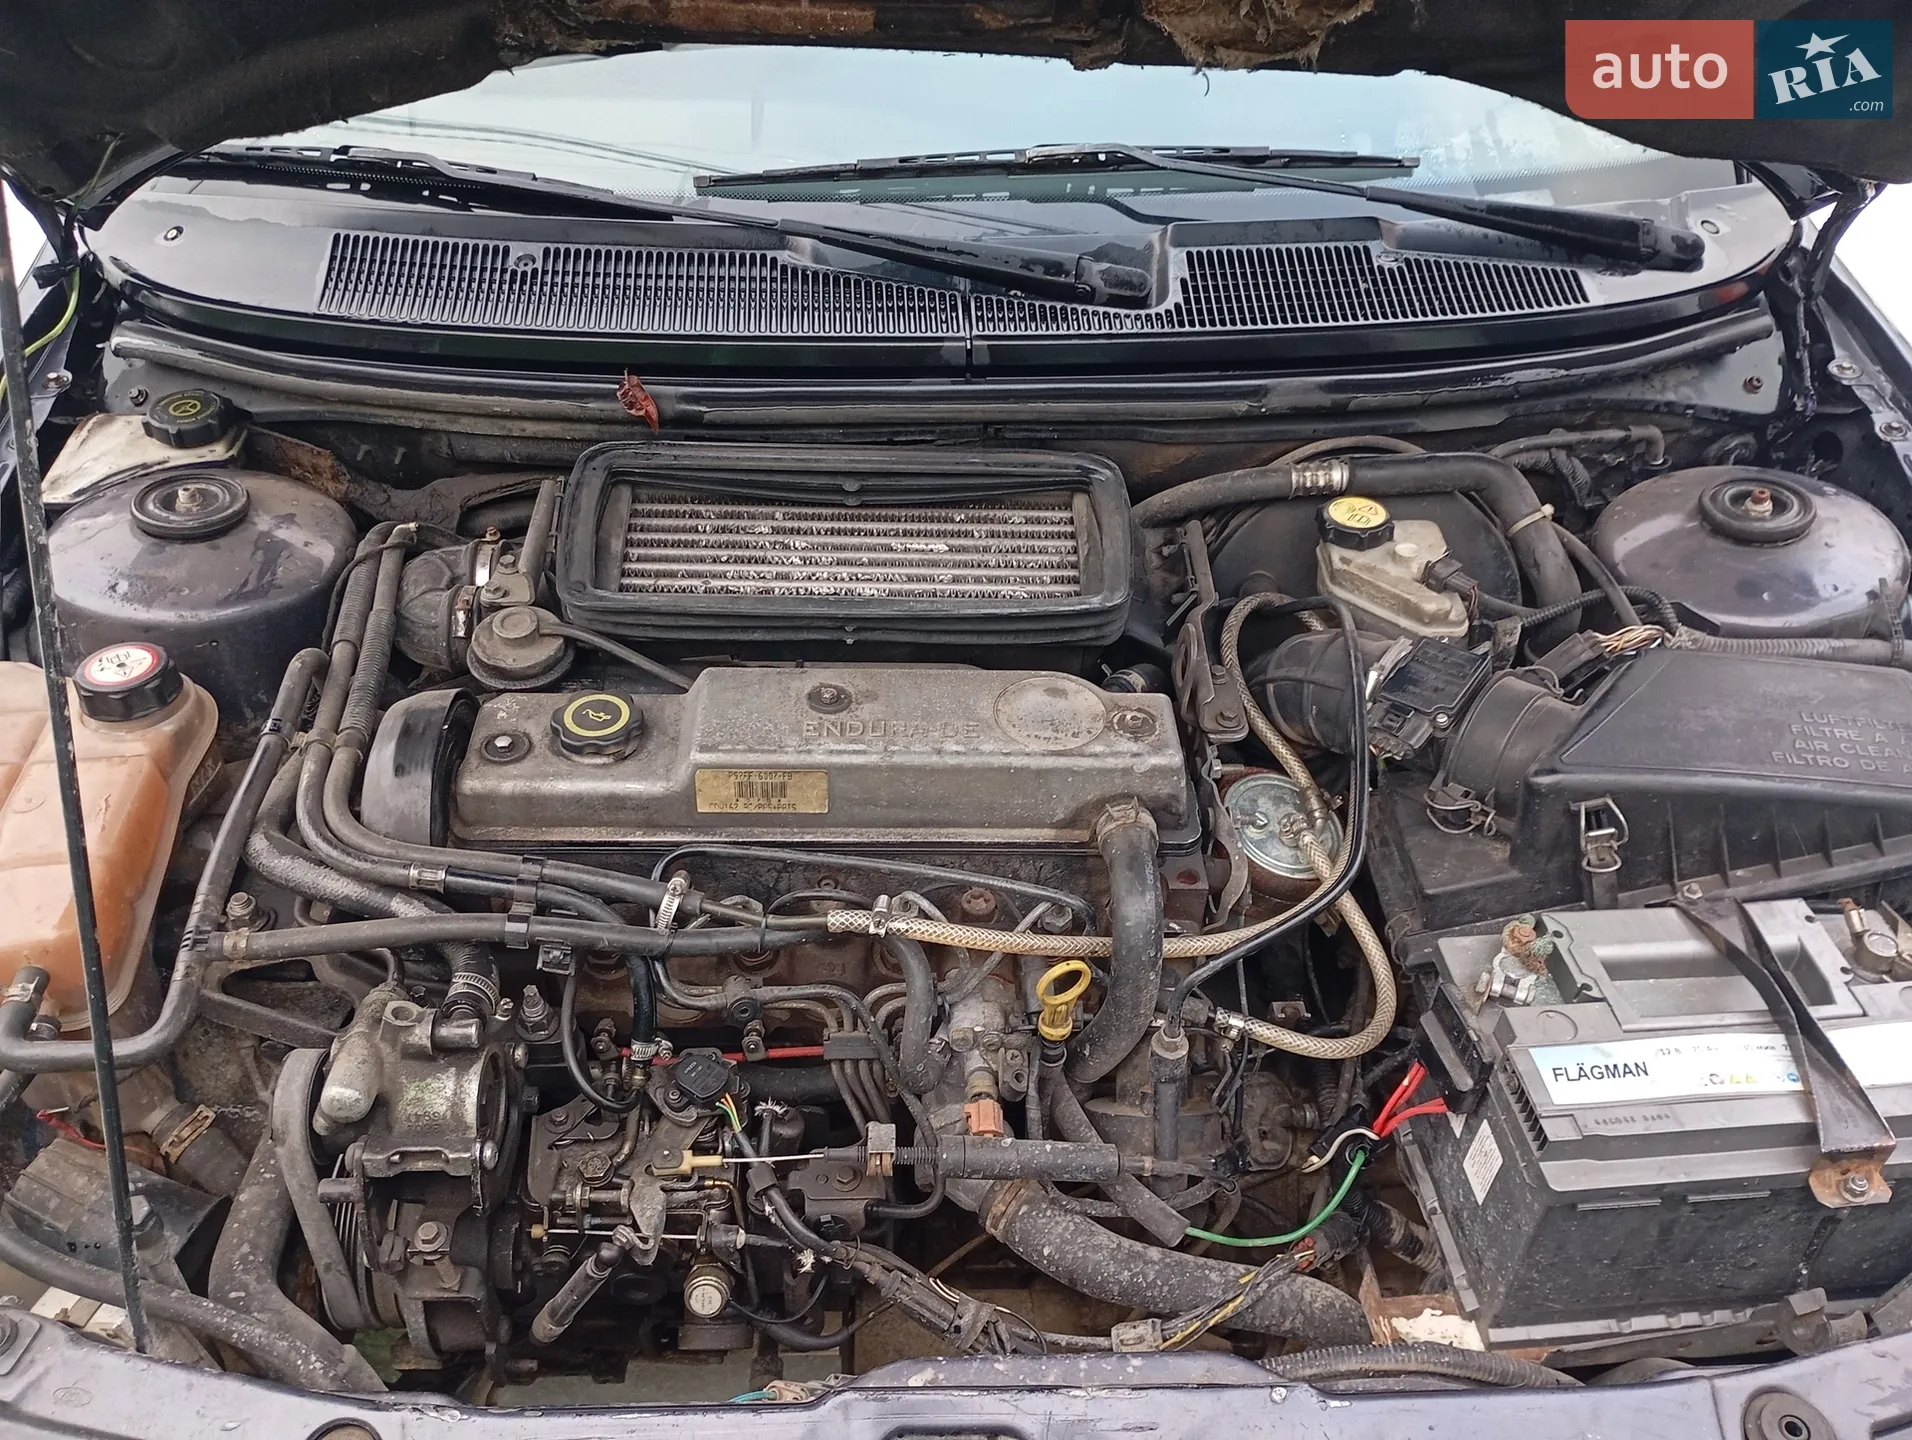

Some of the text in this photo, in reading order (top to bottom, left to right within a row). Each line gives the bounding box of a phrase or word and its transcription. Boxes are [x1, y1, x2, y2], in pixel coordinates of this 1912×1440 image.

[1791, 724, 1863, 741] FILTRE
[1794, 739, 1830, 752] AIR
[1771, 751, 1850, 769] FILTRO
[1860, 759, 1891, 772] DE
[1552, 1061, 1649, 1082] FLÄGMAN
